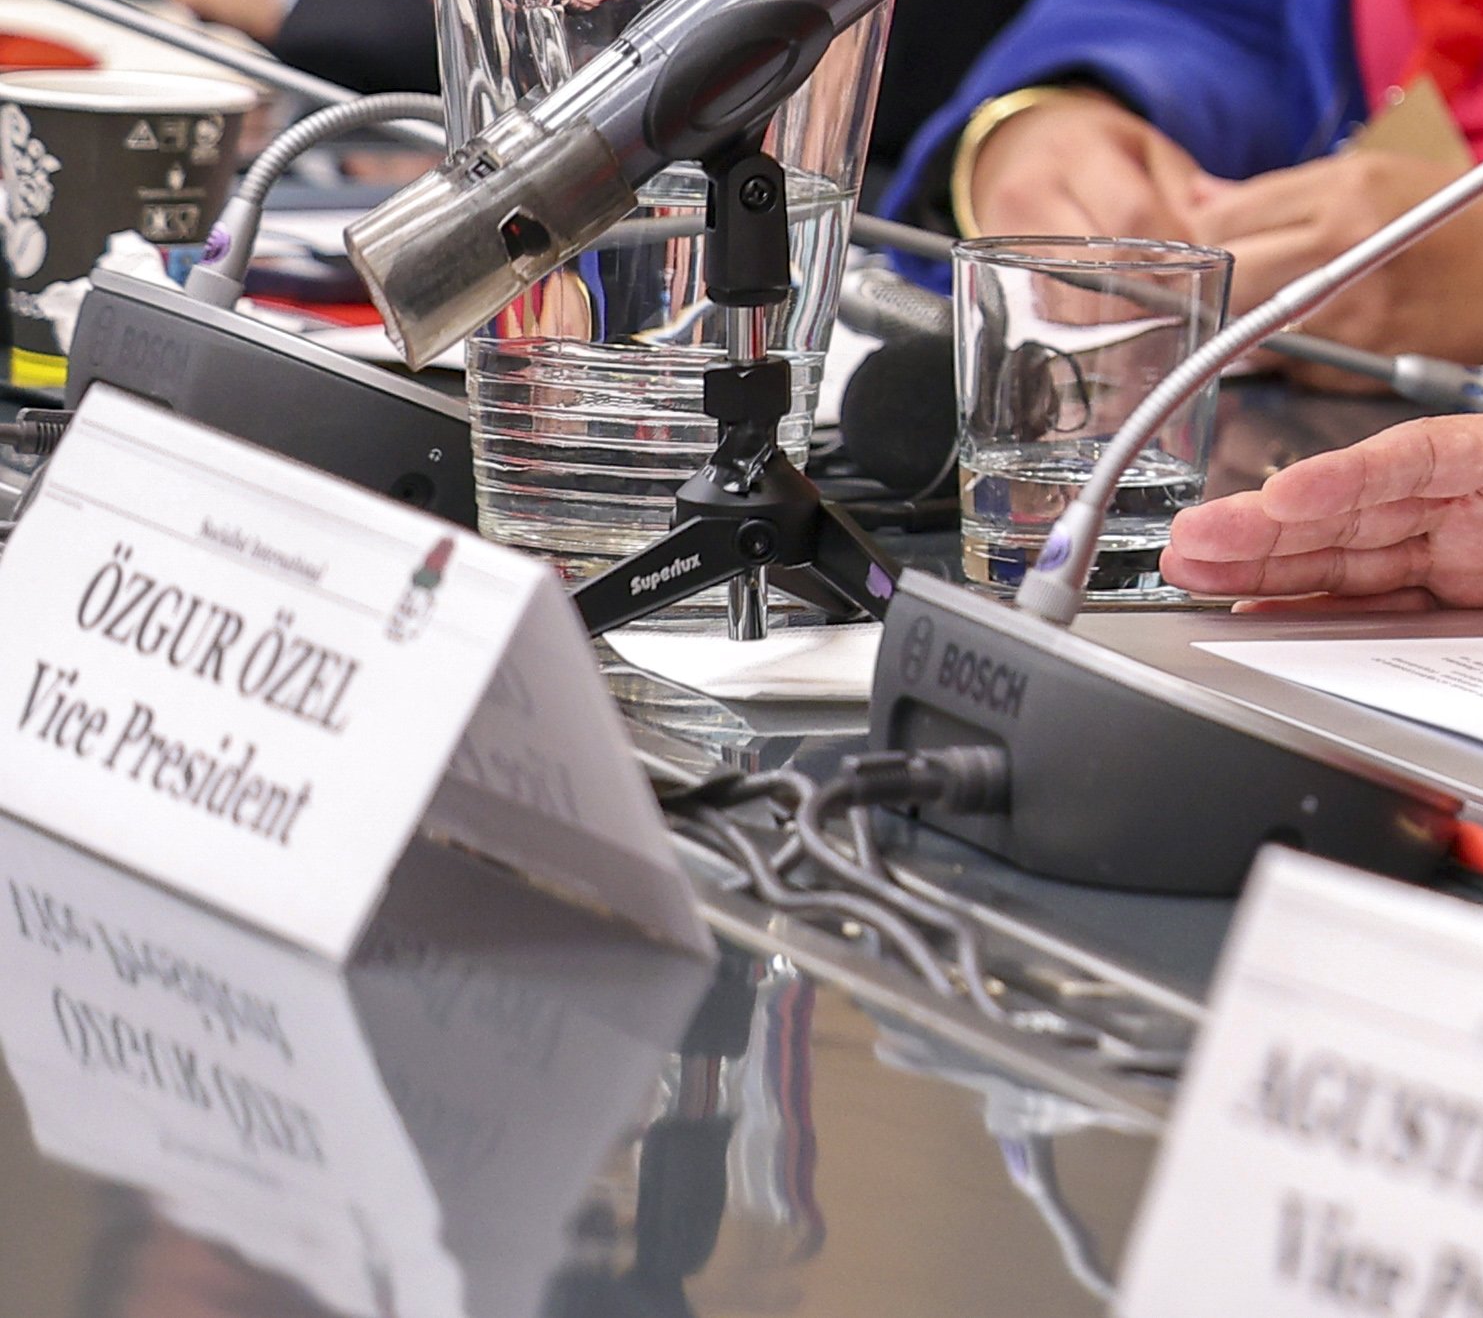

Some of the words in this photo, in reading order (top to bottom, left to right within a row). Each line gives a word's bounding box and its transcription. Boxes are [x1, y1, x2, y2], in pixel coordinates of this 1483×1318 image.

[77, 541, 245, 687] ÖZGUR
[237, 607, 362, 736] ÖZEL
[630, 554, 702, 596] Superlux
[938, 642, 1028, 719] BOSCH
[17, 659, 108, 757] Vice
[100, 700, 313, 846] President
[1274, 1186, 1416, 1316] Vice
